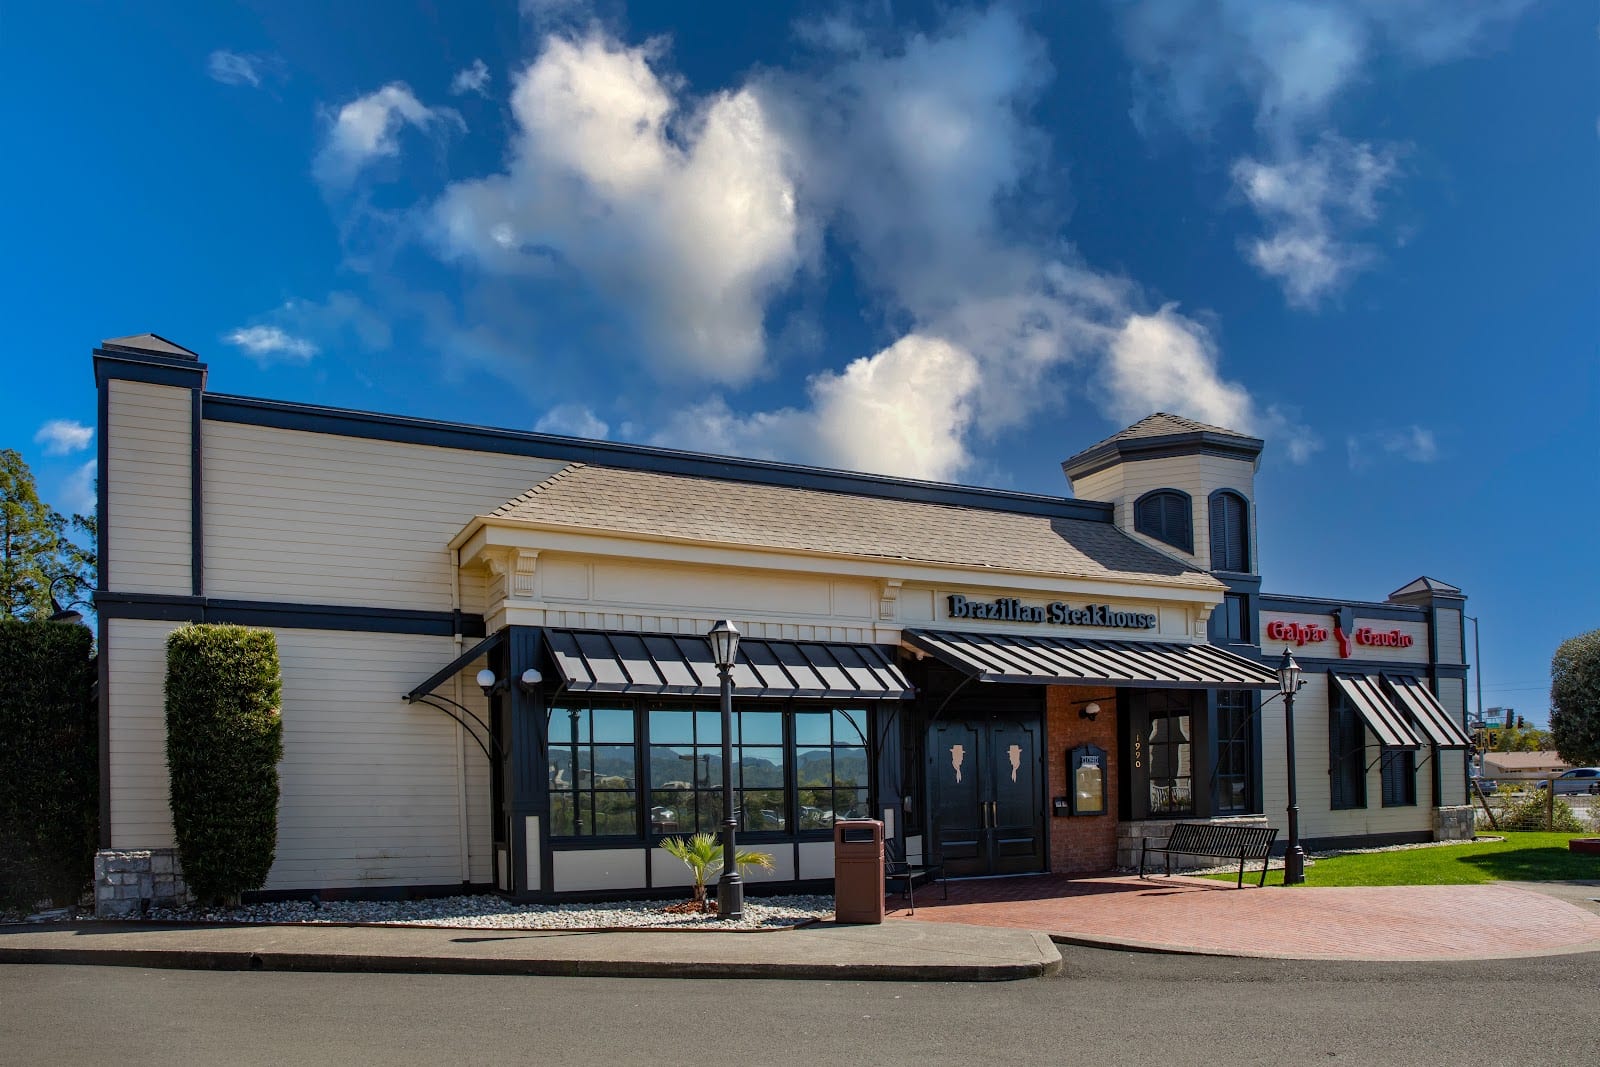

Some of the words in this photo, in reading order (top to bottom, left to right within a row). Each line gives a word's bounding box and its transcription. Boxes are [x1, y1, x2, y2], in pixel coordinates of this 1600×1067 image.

[949, 594, 1045, 623] Brazilian
[1050, 601, 1156, 629] Steakhouse
[1356, 628, 1413, 648] Gaucho
